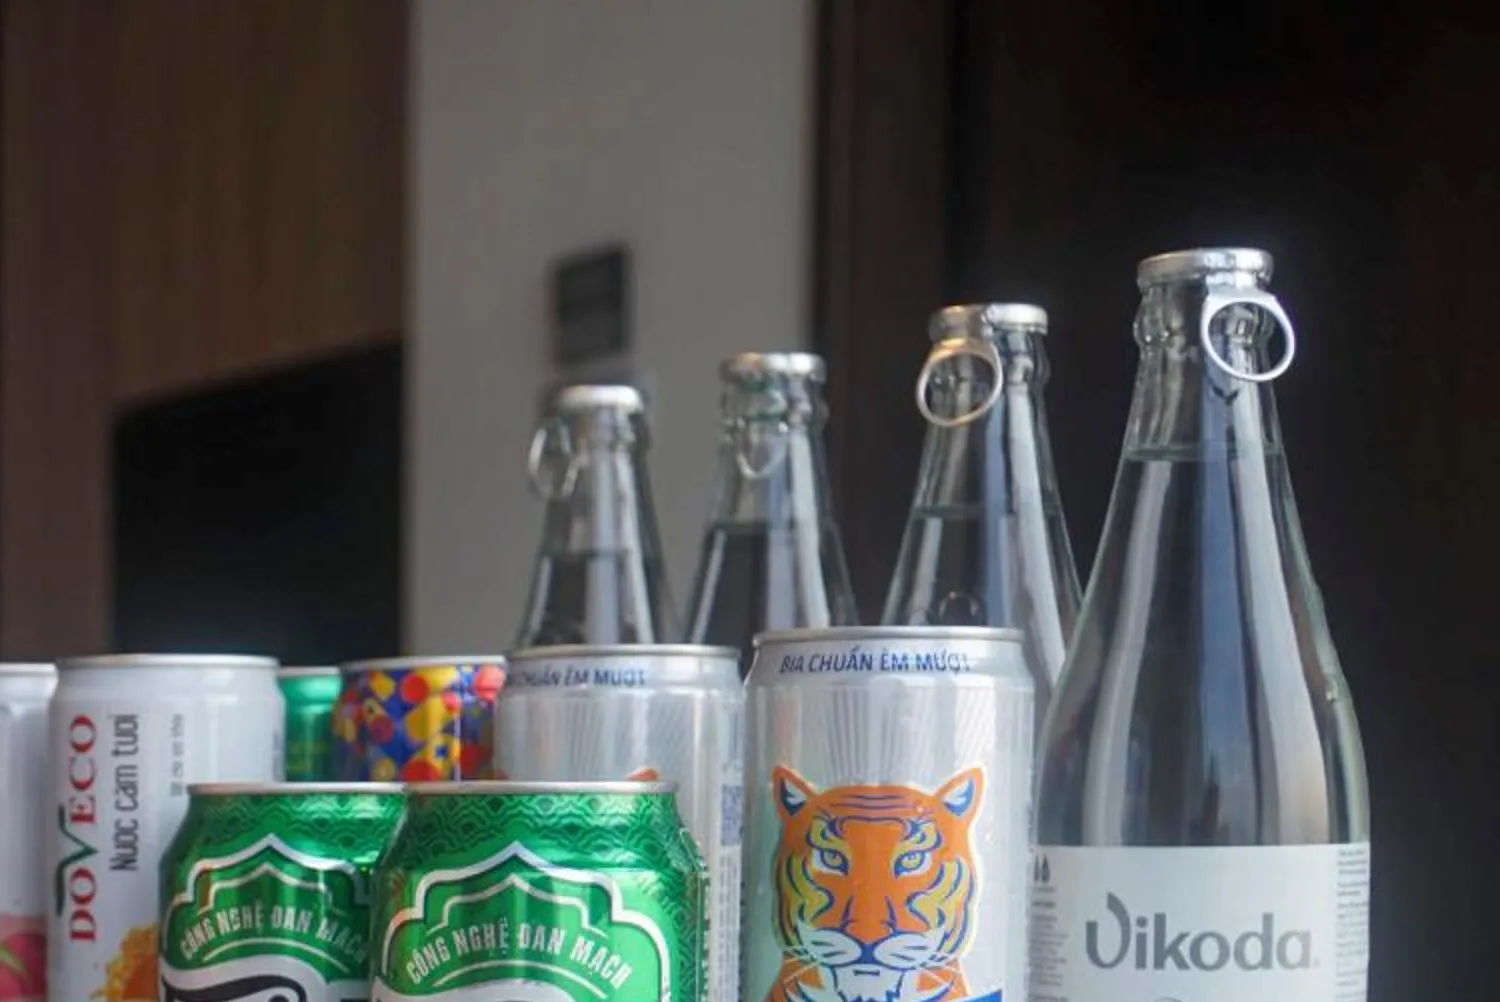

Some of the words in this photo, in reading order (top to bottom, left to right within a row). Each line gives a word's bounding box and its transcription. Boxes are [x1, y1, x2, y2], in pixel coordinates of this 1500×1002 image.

[780, 655, 804, 674] BIA
[113, 765, 139, 813] cam
[56, 714, 99, 942] DOVECO
[1086, 891, 1313, 972] Vikoda
